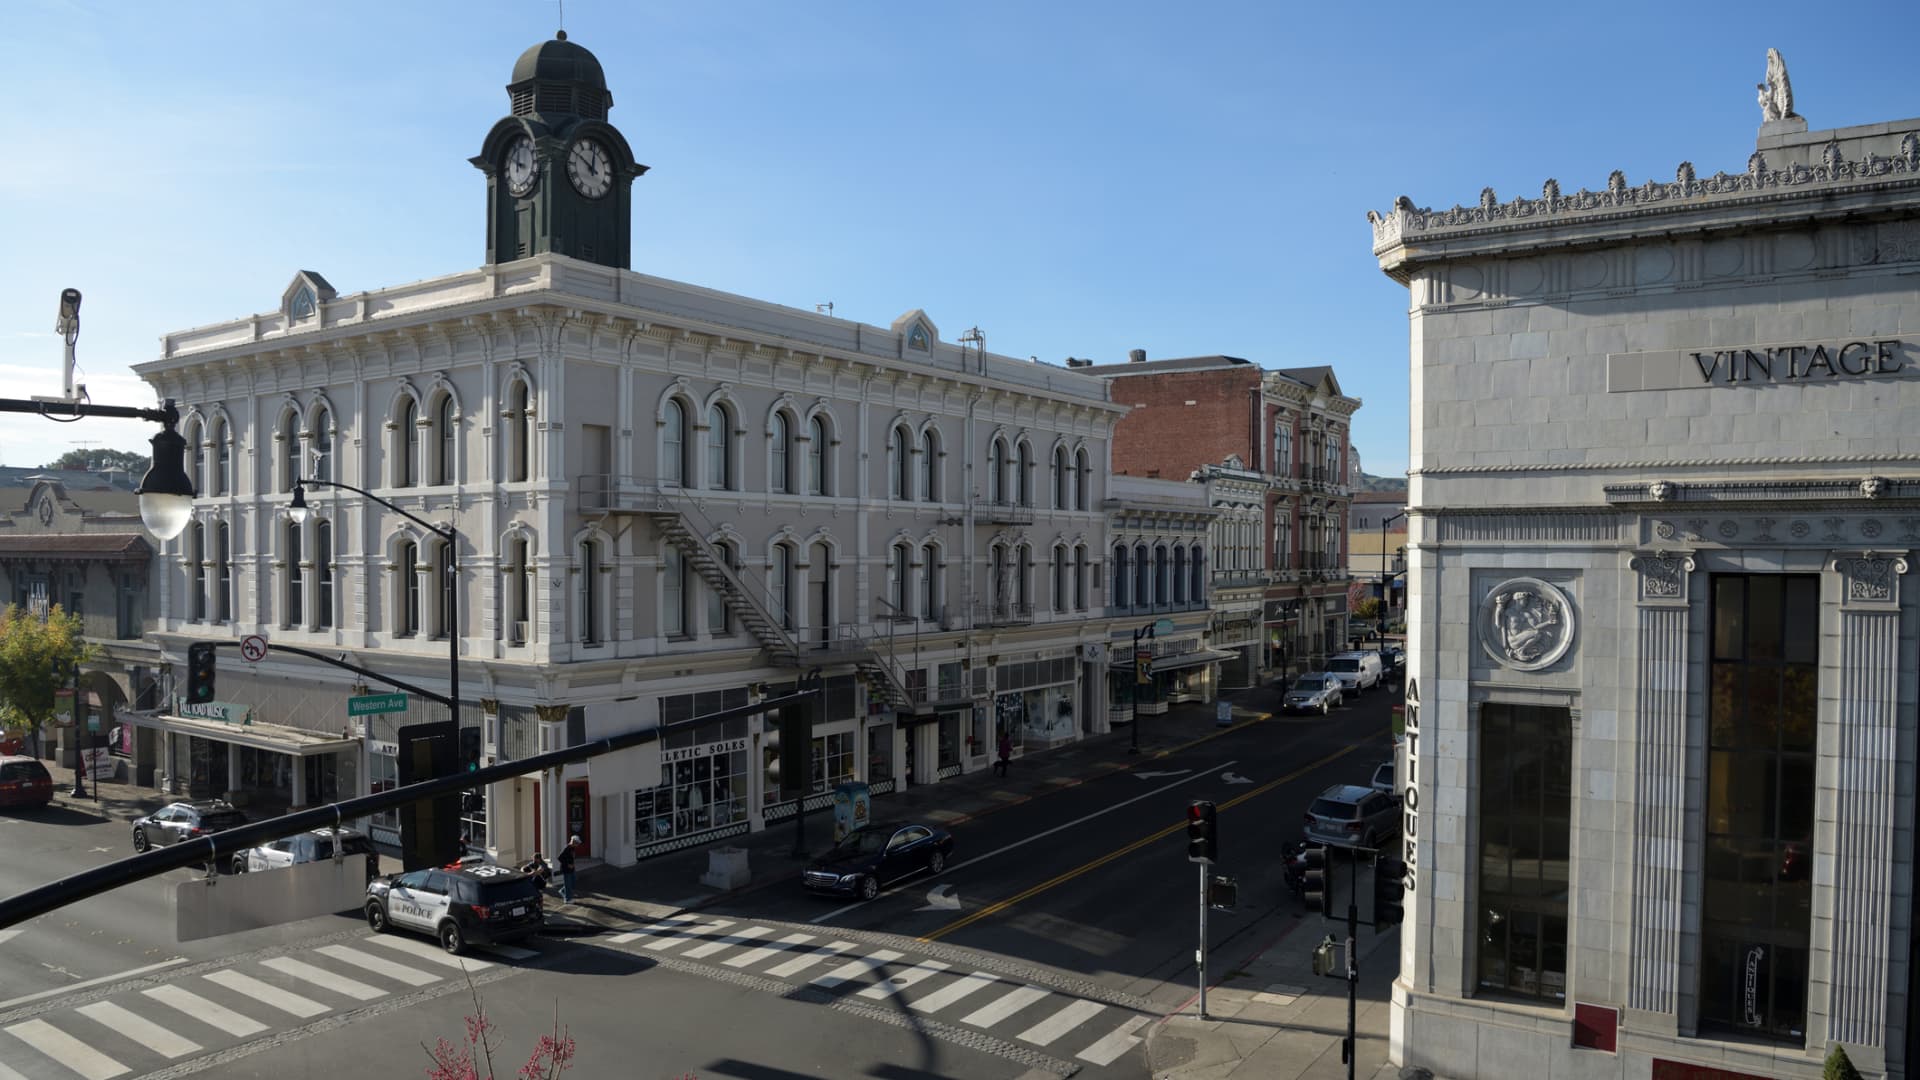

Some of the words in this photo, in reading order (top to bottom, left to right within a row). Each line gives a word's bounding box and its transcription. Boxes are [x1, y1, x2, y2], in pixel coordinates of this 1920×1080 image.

[1690, 339, 1904, 383] VINTAGE
[352, 701, 386, 711] Western
[387, 698, 404, 708] Ave
[661, 748, 702, 762] LETIC
[710, 740, 745, 754] SOLES
[1405, 677, 1420, 892] ANTIQUES
[402, 904, 433, 920] POLICE
